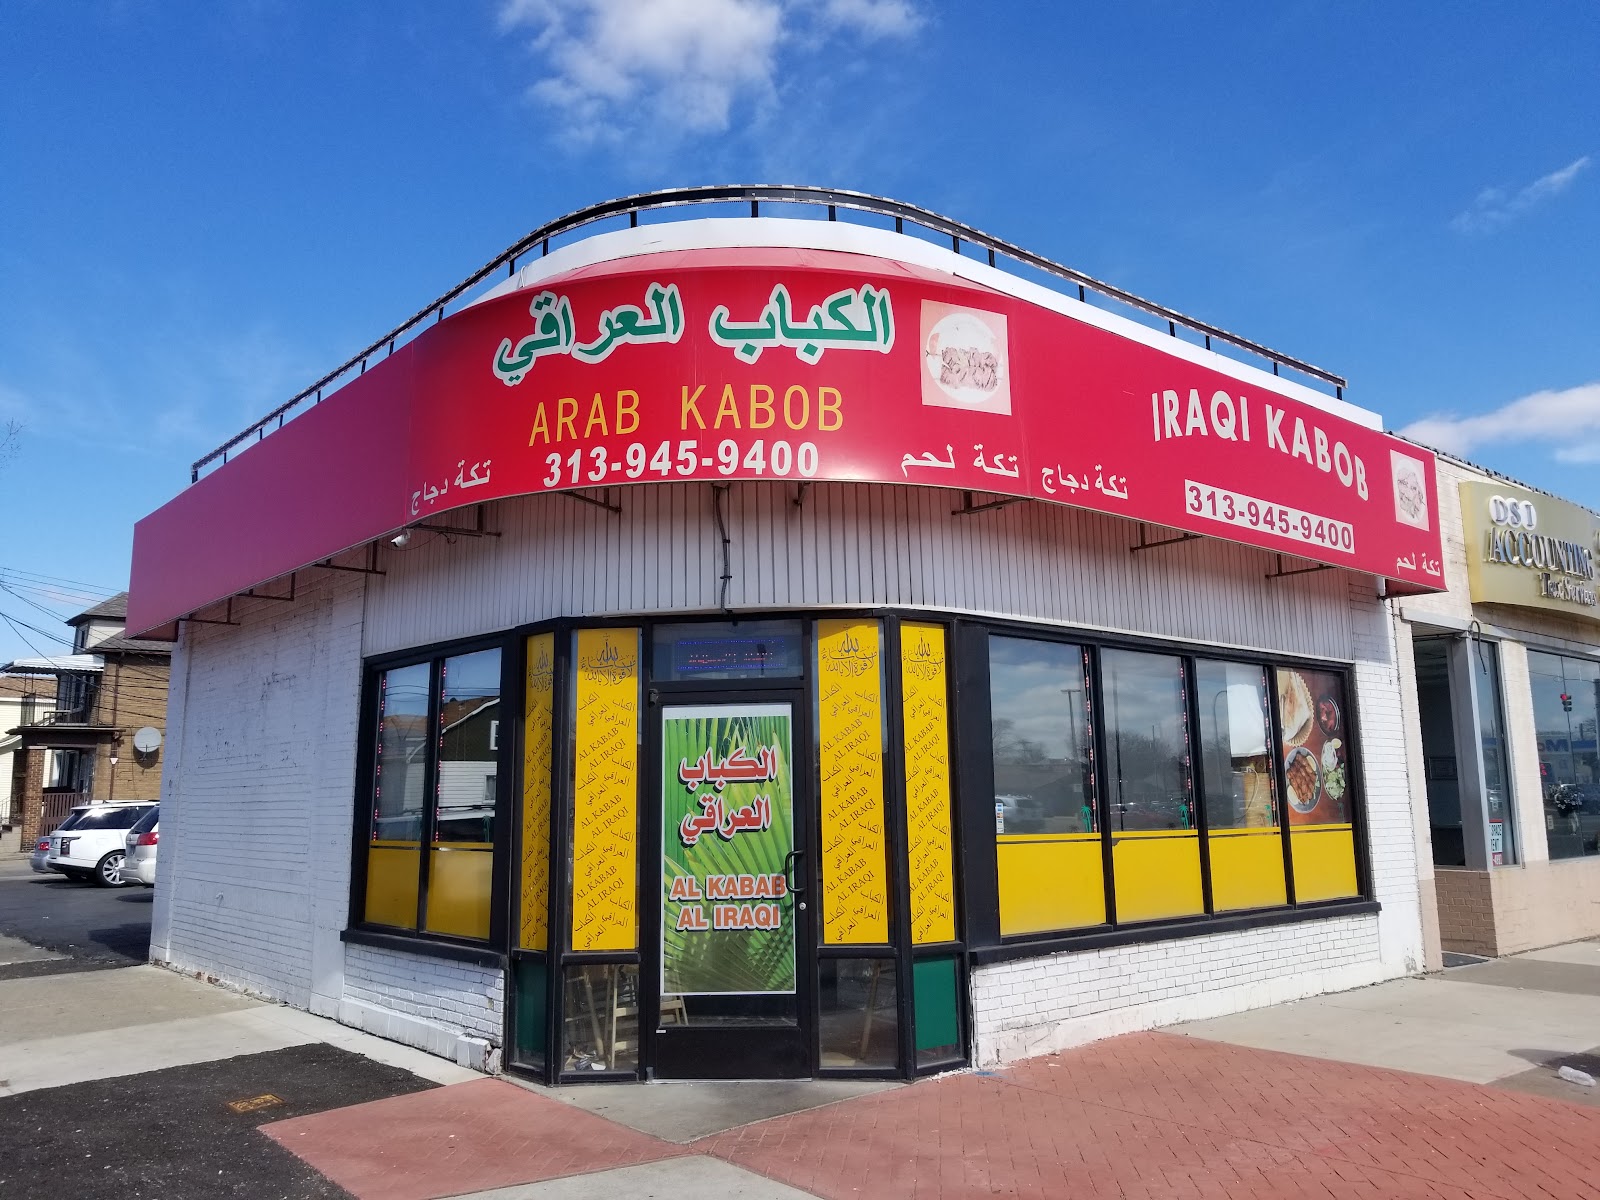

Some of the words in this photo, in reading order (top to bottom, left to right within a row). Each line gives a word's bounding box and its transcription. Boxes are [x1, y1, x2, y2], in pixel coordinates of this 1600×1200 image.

[493, 281, 685, 387] العراقي
[709, 283, 896, 365] الكباب
[529, 389, 640, 447] ARAB
[681, 383, 843, 431] KABOB
[901, 443, 956, 479] لحم
[973, 443, 1019, 478] تكة
[1152, 388, 1250, 442] IRAQI
[1265, 403, 1369, 502] KABOB
[453, 459, 492, 489] تكة
[543, 439, 819, 488] 313-945-9400
[1041, 464, 1089, 494] دجاج
[411, 478, 449, 516] دجاج
[1095, 464, 1129, 500] تكة
[1188, 485, 1352, 550] 313-945-9400
[1492, 498, 1534, 528] DSI
[1396, 551, 1417, 575] لحم
[1421, 552, 1441, 577] تكة
[1489, 527, 1595, 580] ACCOUNTING
[578, 749, 591, 761] AL
[590, 727, 619, 752] KABAB
[822, 740, 834, 752] AL
[833, 718, 862, 743] KABAB
[834, 750, 846, 762] AL
[844, 730, 870, 752] IRAQI
[904, 742, 914, 754] AL
[912, 722, 934, 744] KABAB
[913, 752, 922, 763] AL
[920, 734, 940, 754] IRAQI
[589, 758, 601, 770] AL
[600, 739, 626, 760] IRAQI
[680, 745, 777, 791] الكباب
[581, 817, 594, 829] AL
[592, 794, 622, 820] KABAB
[680, 794, 771, 845] العراقي
[828, 810, 840, 821] AL
[838, 786, 868, 811] KABAB
[840, 819, 852, 830] AL
[850, 798, 876, 820] IRAQI
[910, 810, 918, 822] AL
[918, 788, 939, 812] KABAB
[918, 820, 928, 831] AL
[926, 800, 945, 822] IRAQI
[592, 826, 604, 838] AL
[603, 806, 630, 829] IRAQI
[576, 889, 588, 901] AL
[588, 866, 617, 891] KABAB
[669, 875, 702, 900] AL
[706, 874, 787, 899] KABAB
[826, 882, 838, 894] AL
[836, 858, 867, 884] KABAB
[837, 892, 850, 904] AL
[848, 870, 874, 894] IRAQI
[910, 882, 918, 894] AL
[917, 858, 939, 884] KABAB
[918, 892, 927, 904] AL
[926, 870, 945, 893] IRAQI
[587, 898, 600, 910] AL
[598, 878, 624, 901] IRAQI
[676, 905, 709, 930] AL
[713, 904, 780, 930] IRAQI
